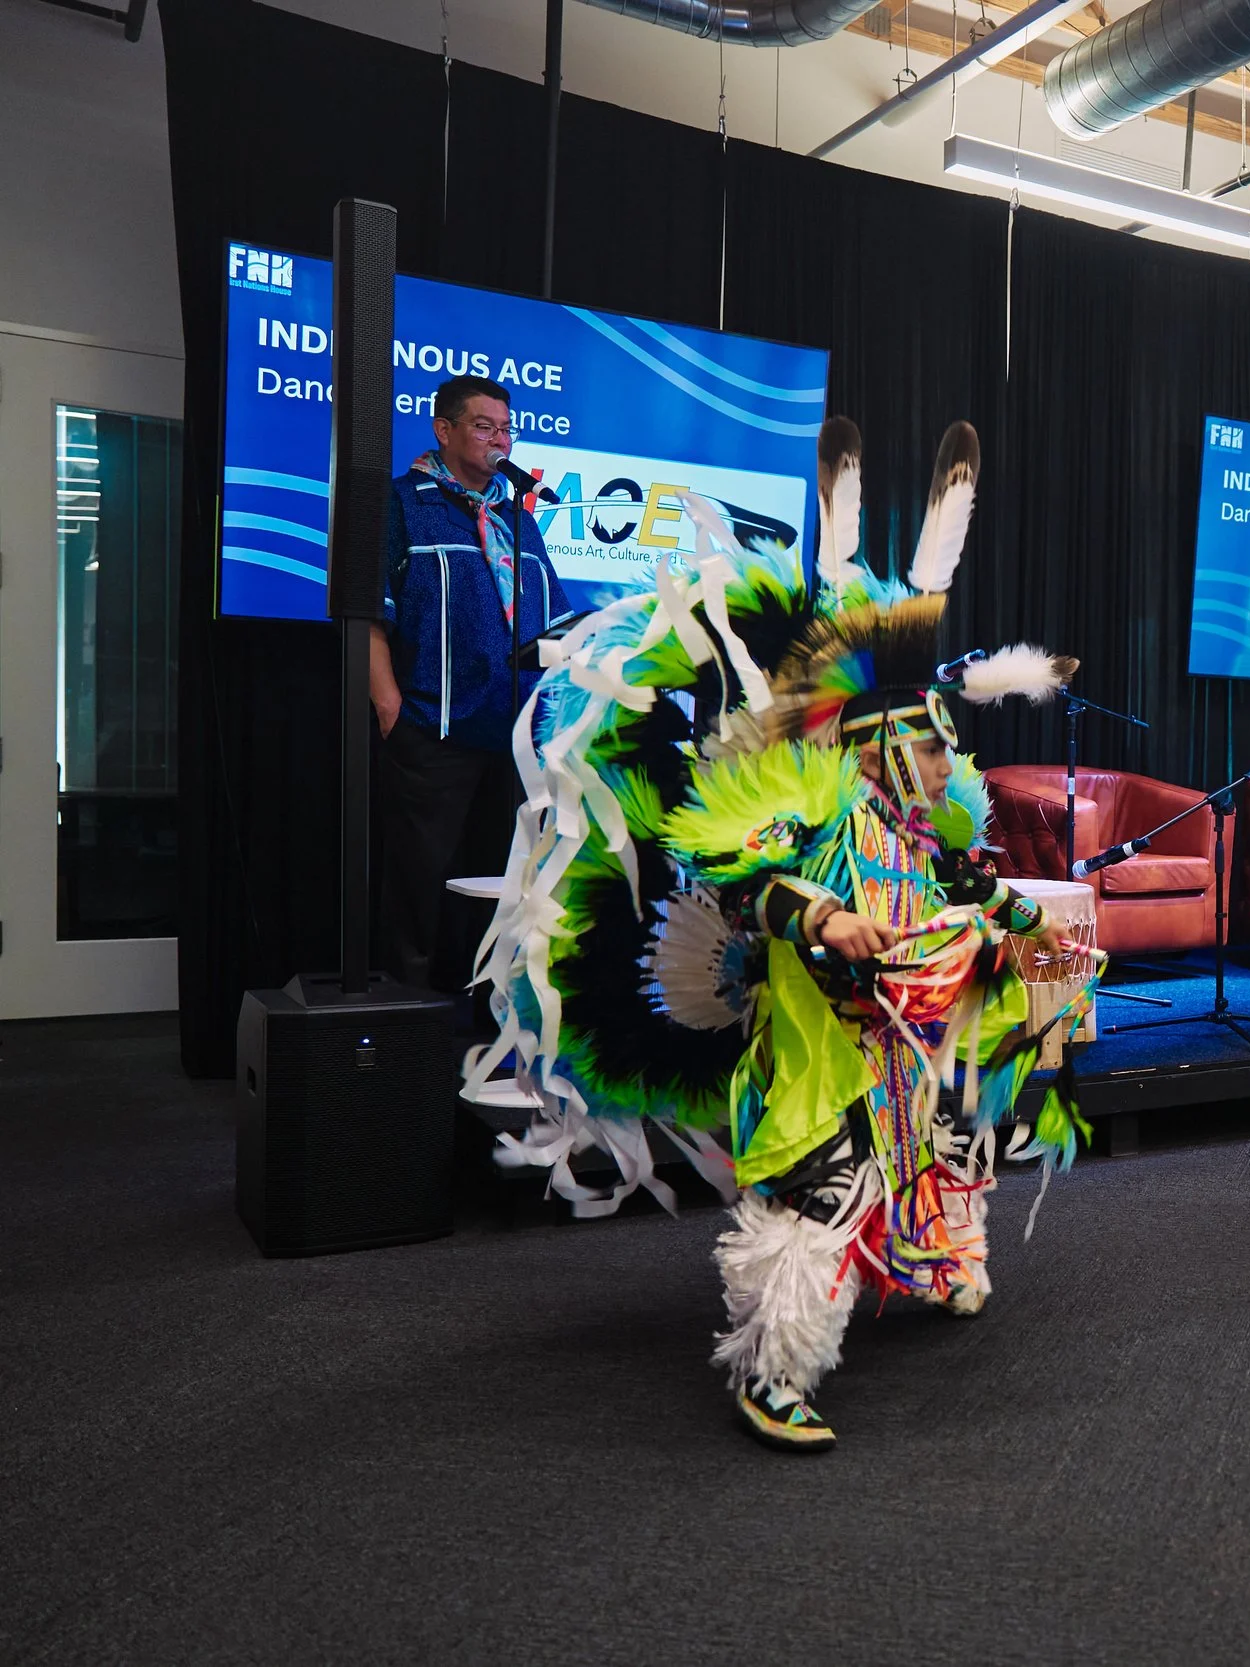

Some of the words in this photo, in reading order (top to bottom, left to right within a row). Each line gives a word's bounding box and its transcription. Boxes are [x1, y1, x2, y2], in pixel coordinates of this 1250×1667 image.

[229, 246, 293, 288] FNH
[258, 317, 490, 379] INDNOUS
[497, 358, 563, 391] ACE
[258, 367, 333, 402] Dan
[585, 544, 605, 559] Art,
[608, 547, 653, 565] Culture,
